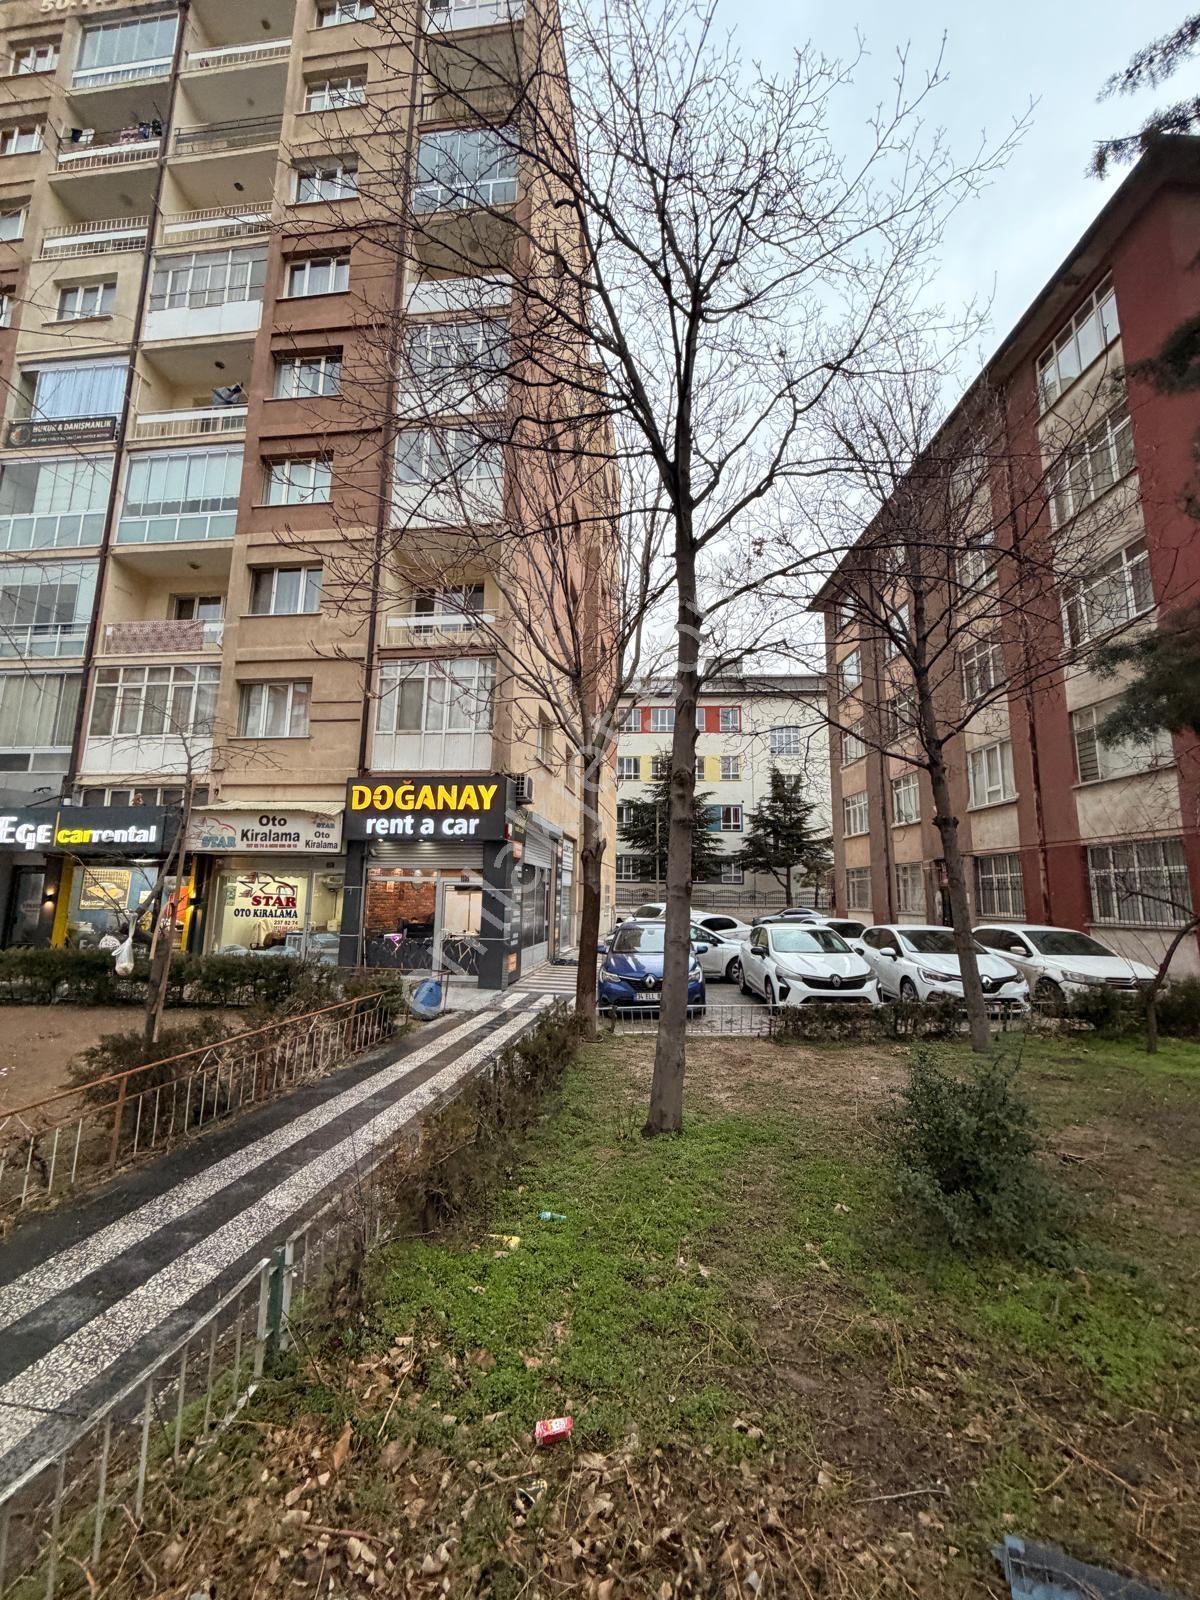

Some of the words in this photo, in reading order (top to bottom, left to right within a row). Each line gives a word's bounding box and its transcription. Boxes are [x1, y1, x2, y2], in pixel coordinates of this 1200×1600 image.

[351, 780, 498, 810] DOĞANAY
[258, 815, 287, 827] Oto
[366, 815, 413, 834] rent
[420, 818, 434, 834] a
[442, 818, 479, 834] car
[240, 829, 300, 842] Kiralama
[314, 831, 330, 839] Oto
[201, 836, 236, 848] STAR
[305, 840, 338, 849] Kiralama
[251, 896, 297, 907] STAR
[234, 908, 251, 918] OTO
